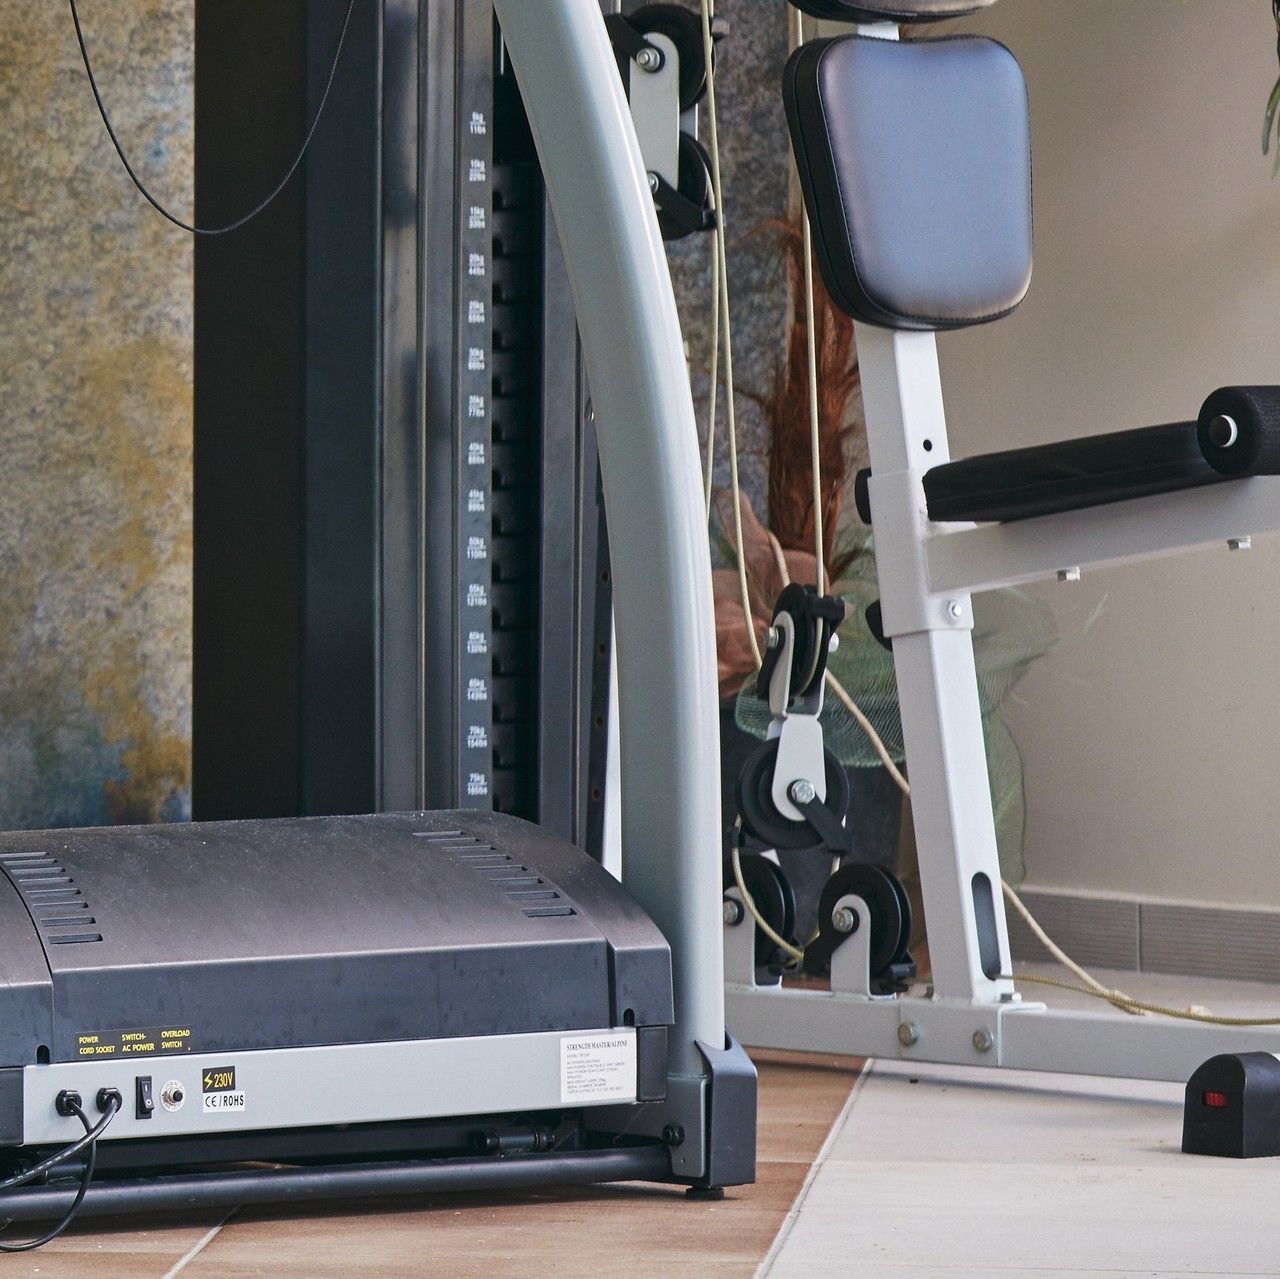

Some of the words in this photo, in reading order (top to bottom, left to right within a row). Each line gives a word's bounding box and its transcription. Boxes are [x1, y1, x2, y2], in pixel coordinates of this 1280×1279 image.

[161, 1030, 191, 1038] OVERLOAD
[79, 1036, 99, 1044] POWER
[133, 1043, 155, 1051] POWER
[161, 1041, 183, 1049] SWITCH
[80, 1047, 95, 1055] CORD
[96, 1046, 115, 1054] SOCKET
[214, 1072, 233, 1088] 230V
